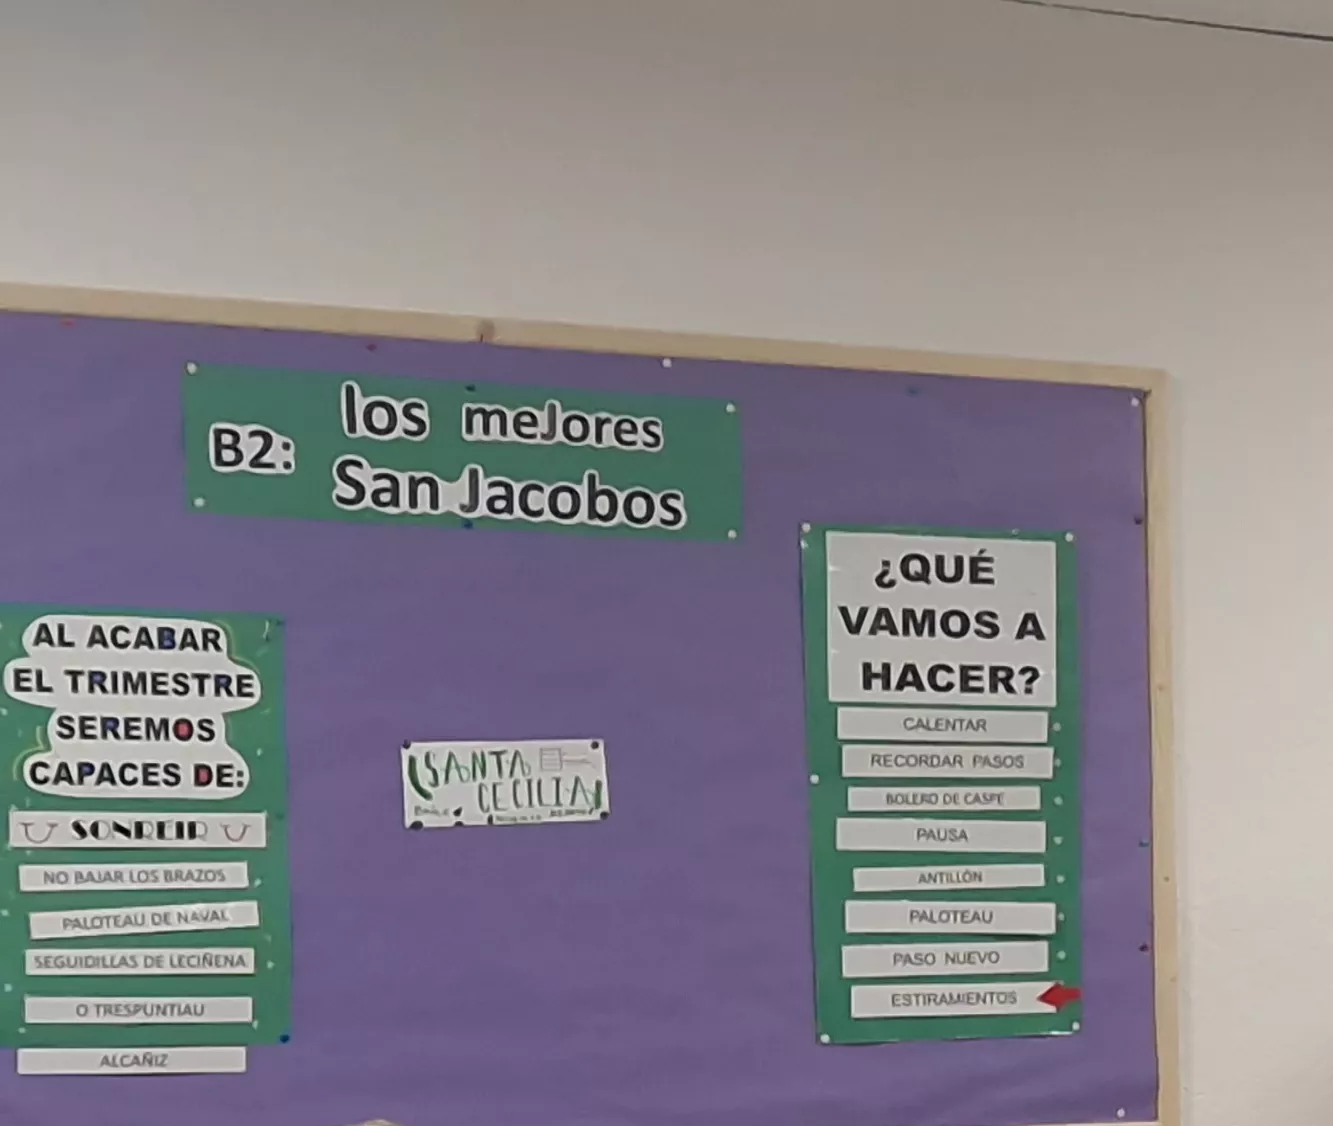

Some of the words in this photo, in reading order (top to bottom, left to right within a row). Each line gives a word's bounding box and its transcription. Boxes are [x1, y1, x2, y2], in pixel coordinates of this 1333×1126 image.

[344, 382, 428, 436] los
[212, 427, 294, 471] B2:
[336, 457, 440, 509] San
[460, 466, 684, 528] Jacobos
[874, 549, 995, 589] ¿QUÉ
[838, 605, 1000, 640] VAMOS
[1015, 612, 1046, 641] A
[33, 623, 75, 648] AL
[86, 625, 224, 652] ACABAR
[13, 668, 53, 693] EL
[64, 670, 256, 698] TRIMESTRE
[861, 662, 1041, 695] HACER?
[56, 715, 216, 742] SEREMOS
[903, 717, 988, 732] CALENTAR
[424, 749, 532, 788] SANTA
[870, 754, 964, 769] RECORDAR
[972, 754, 1025, 769] PASOS
[29, 761, 181, 787] CAPACES
[193, 763, 245, 789] DE:
[477, 776, 594, 814] CECILIA
[886, 792, 939, 805] BOLERO
[943, 792, 960, 805] DE
[964, 792, 1005, 805] CASPE
[916, 828, 969, 842] PAUSA
[43, 871, 69, 885] NO
[74, 870, 124, 885] BAJAR
[129, 869, 159, 883] LOS
[163, 868, 226, 883] BRAZOS
[918, 870, 983, 884] ANTILLÓN
[62, 914, 146, 931] PALOTEAU
[151, 912, 172, 926] DE
[177, 909, 230, 924] NAVAL
[909, 909, 993, 924] PALOTEAU
[33, 955, 138, 969] SEGUIDILLAS
[144, 955, 165, 969] DE
[169, 952, 246, 969] LECIÑENA
[893, 953, 936, 966] PASO
[945, 951, 1000, 965] NUEVO
[891, 990, 1018, 1007] ESTIRAMIENTOS
[76, 1003, 89, 1017] O
[95, 1003, 205, 1018] TRESPUNTIAU
[100, 1052, 169, 1068] ALCAÑIZ
